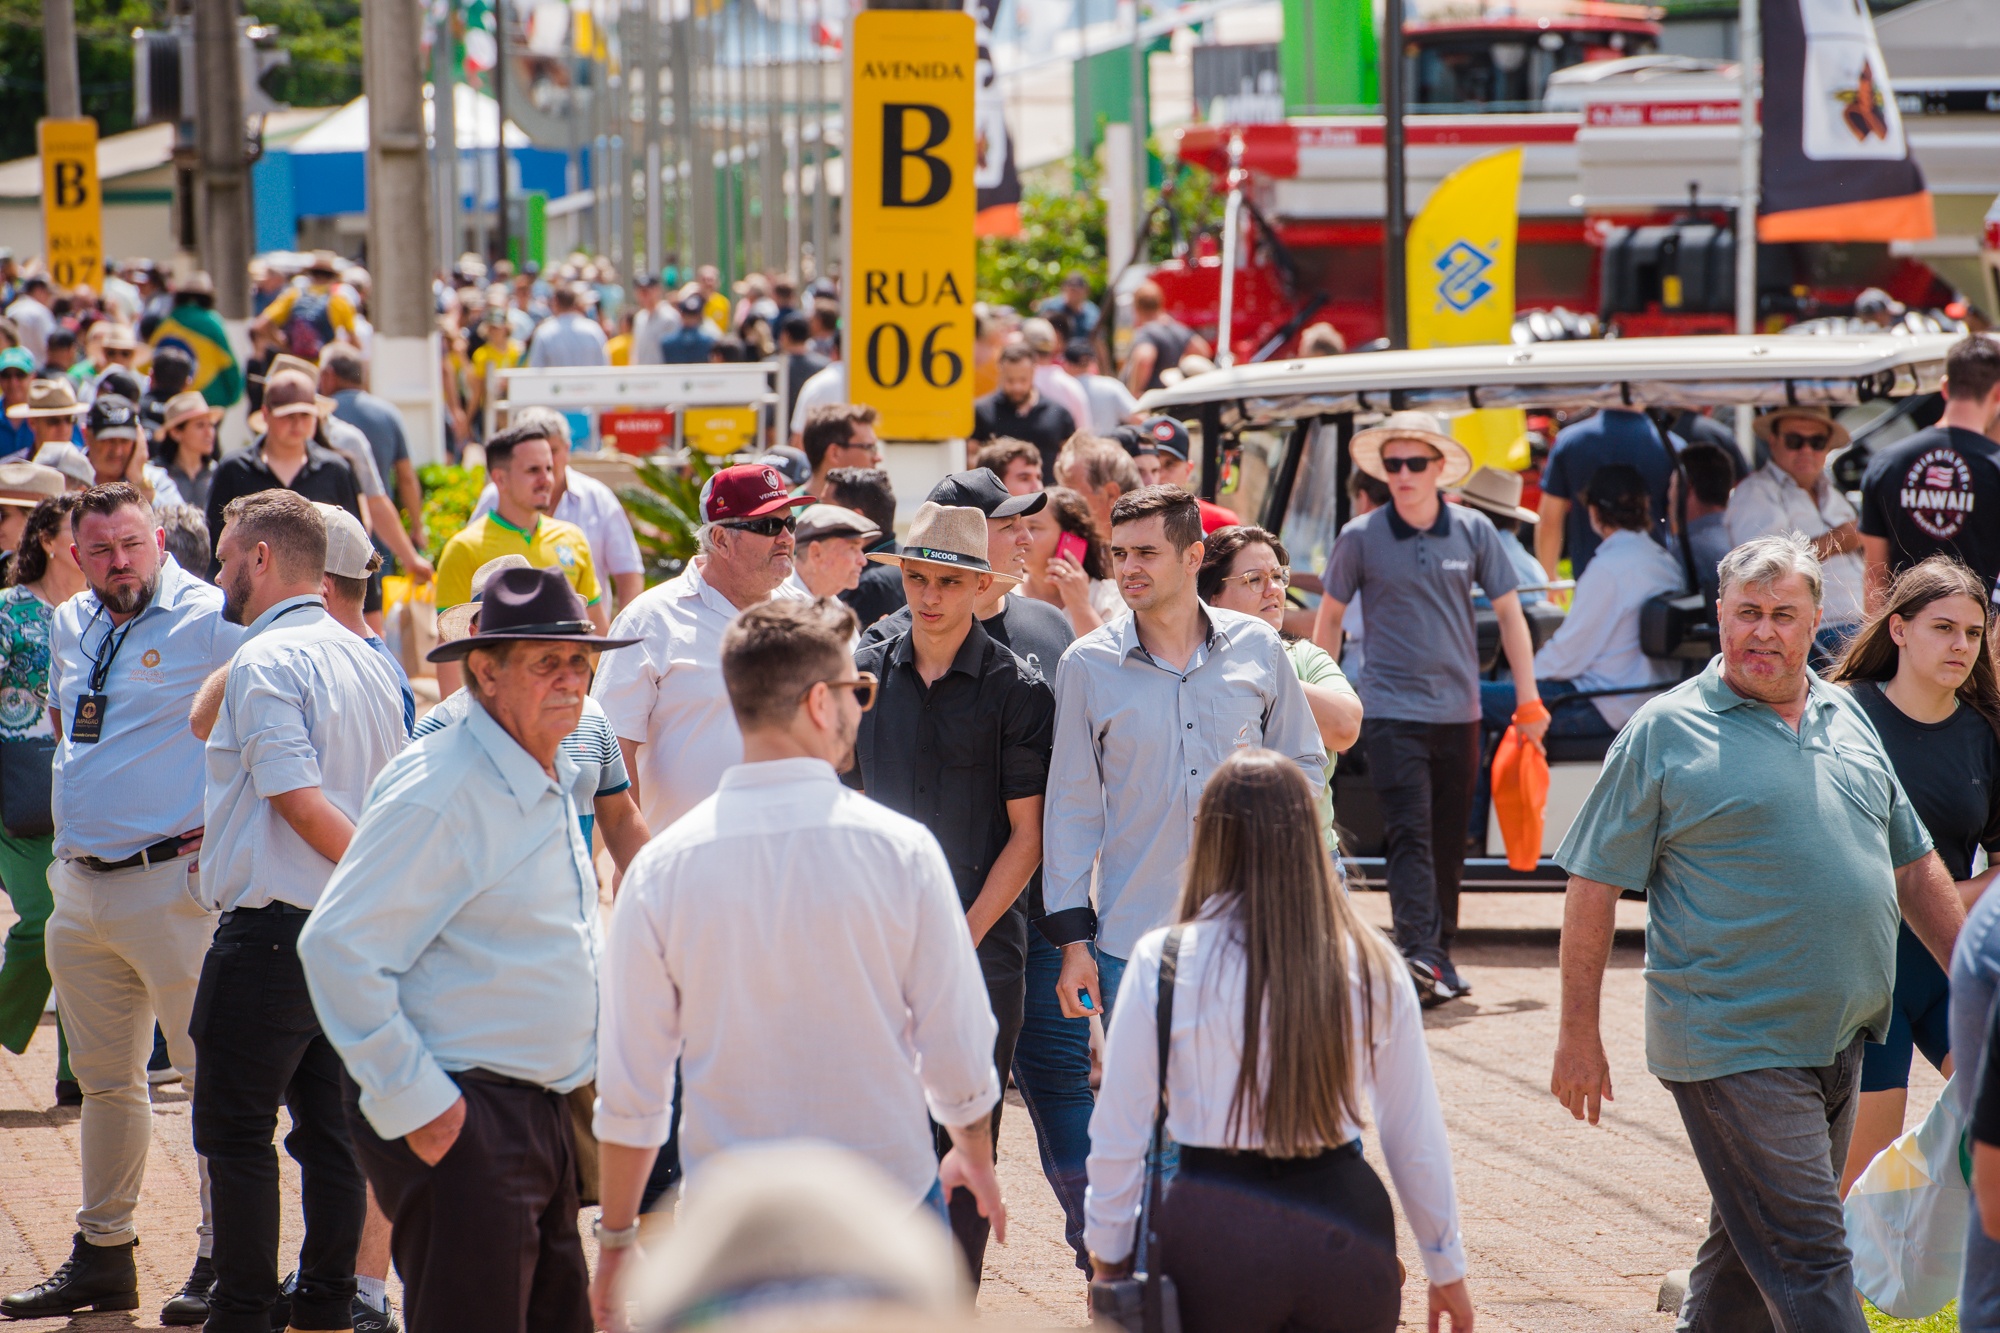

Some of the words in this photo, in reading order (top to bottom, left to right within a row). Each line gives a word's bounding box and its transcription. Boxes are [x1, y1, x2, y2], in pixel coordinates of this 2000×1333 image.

[861, 61, 964, 80] AVENIDA
[881, 102, 953, 208] B
[54, 161, 87, 208] B
[52, 234, 97, 250] RUA
[54, 257, 96, 287] 07
[865, 270, 964, 307] RUA
[866, 322, 964, 389] 06
[758, 490, 779, 500] VENCE
[1901, 488, 1974, 512] HAWAII
[930, 550, 958, 561] SICOOB
